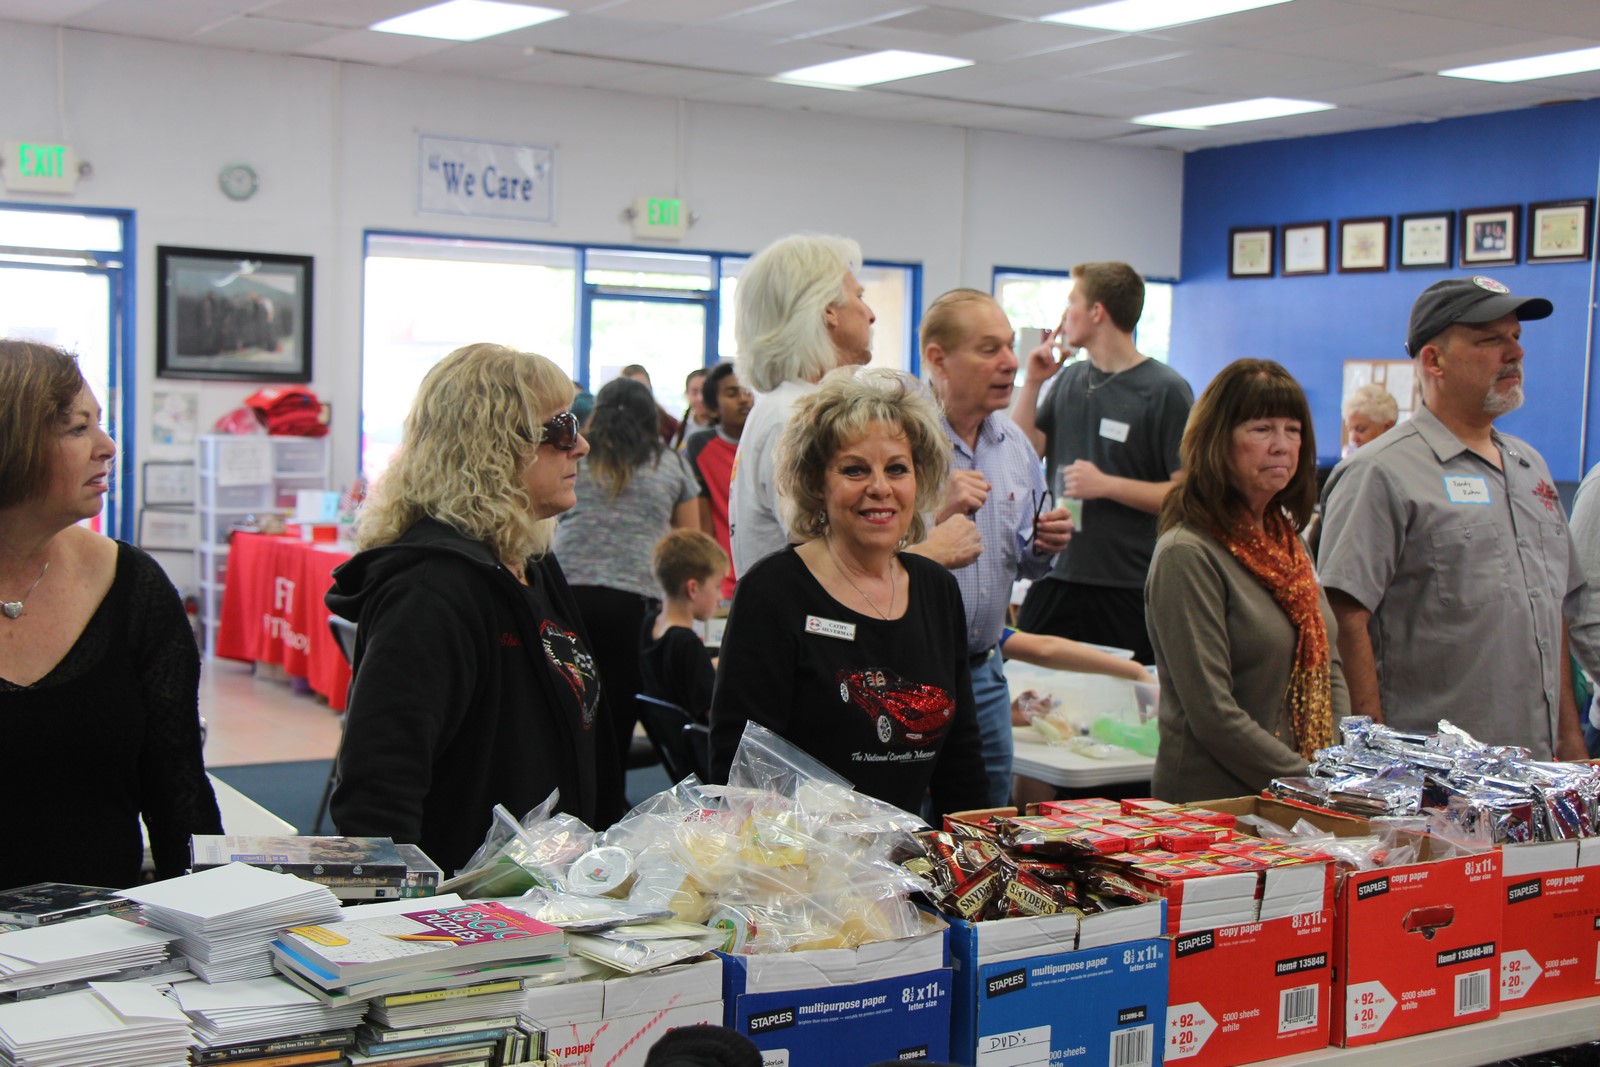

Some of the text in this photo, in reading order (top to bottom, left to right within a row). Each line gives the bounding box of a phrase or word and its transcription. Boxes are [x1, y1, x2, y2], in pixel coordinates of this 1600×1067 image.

[19, 143, 65, 178] EXIT
[647, 198, 680, 226] EXIT
[821, 627, 853, 637] SILVERMAN
[851, 751, 863, 761] The
[863, 752, 890, 762] National
[1482, 858, 1492, 872] 11
[1358, 880, 1387, 896] STAPLES
[1391, 874, 1408, 884] copy
[1409, 871, 1429, 882] paper
[1509, 883, 1540, 899] STAPLES
[1545, 878, 1563, 887] copy
[1564, 875, 1584, 886] paper
[1311, 910, 1321, 924] 11
[417, 913, 485, 942] PUZZLES
[1178, 934, 1212, 952] STAPLES
[1219, 926, 1239, 937] copy
[1240, 923, 1263, 936] paper
[1145, 945, 1157, 960] 11
[1129, 962, 1157, 973] letter size
[1298, 956, 1325, 969] 135848
[1509, 960, 1521, 972] 92
[1560, 957, 1578, 966] sheets
[989, 957, 1108, 992] STAPLES multipurpose paper
[1508, 975, 1520, 987] 20
[926, 982, 938, 998] 11
[1401, 987, 1436, 1000] 5000 sheets
[799, 995, 887, 1014] multipurpose paper
[908, 1000, 937, 1011] letter size
[1361, 992, 1374, 1005] 92
[1401, 1001, 1418, 1011] white
[751, 1011, 793, 1029] STAPLES
[1180, 1014, 1194, 1028] 92
[1222, 1008, 1260, 1022] 5000 sheets
[1361, 1008, 1374, 1021] 20
[1222, 1023, 1240, 1033] white
[990, 1032, 1027, 1050] DVD's
[1179, 1031, 1193, 1045] 20
[565, 1043, 595, 1058] paper
[1049, 1046, 1086, 1060] 000 sheets
